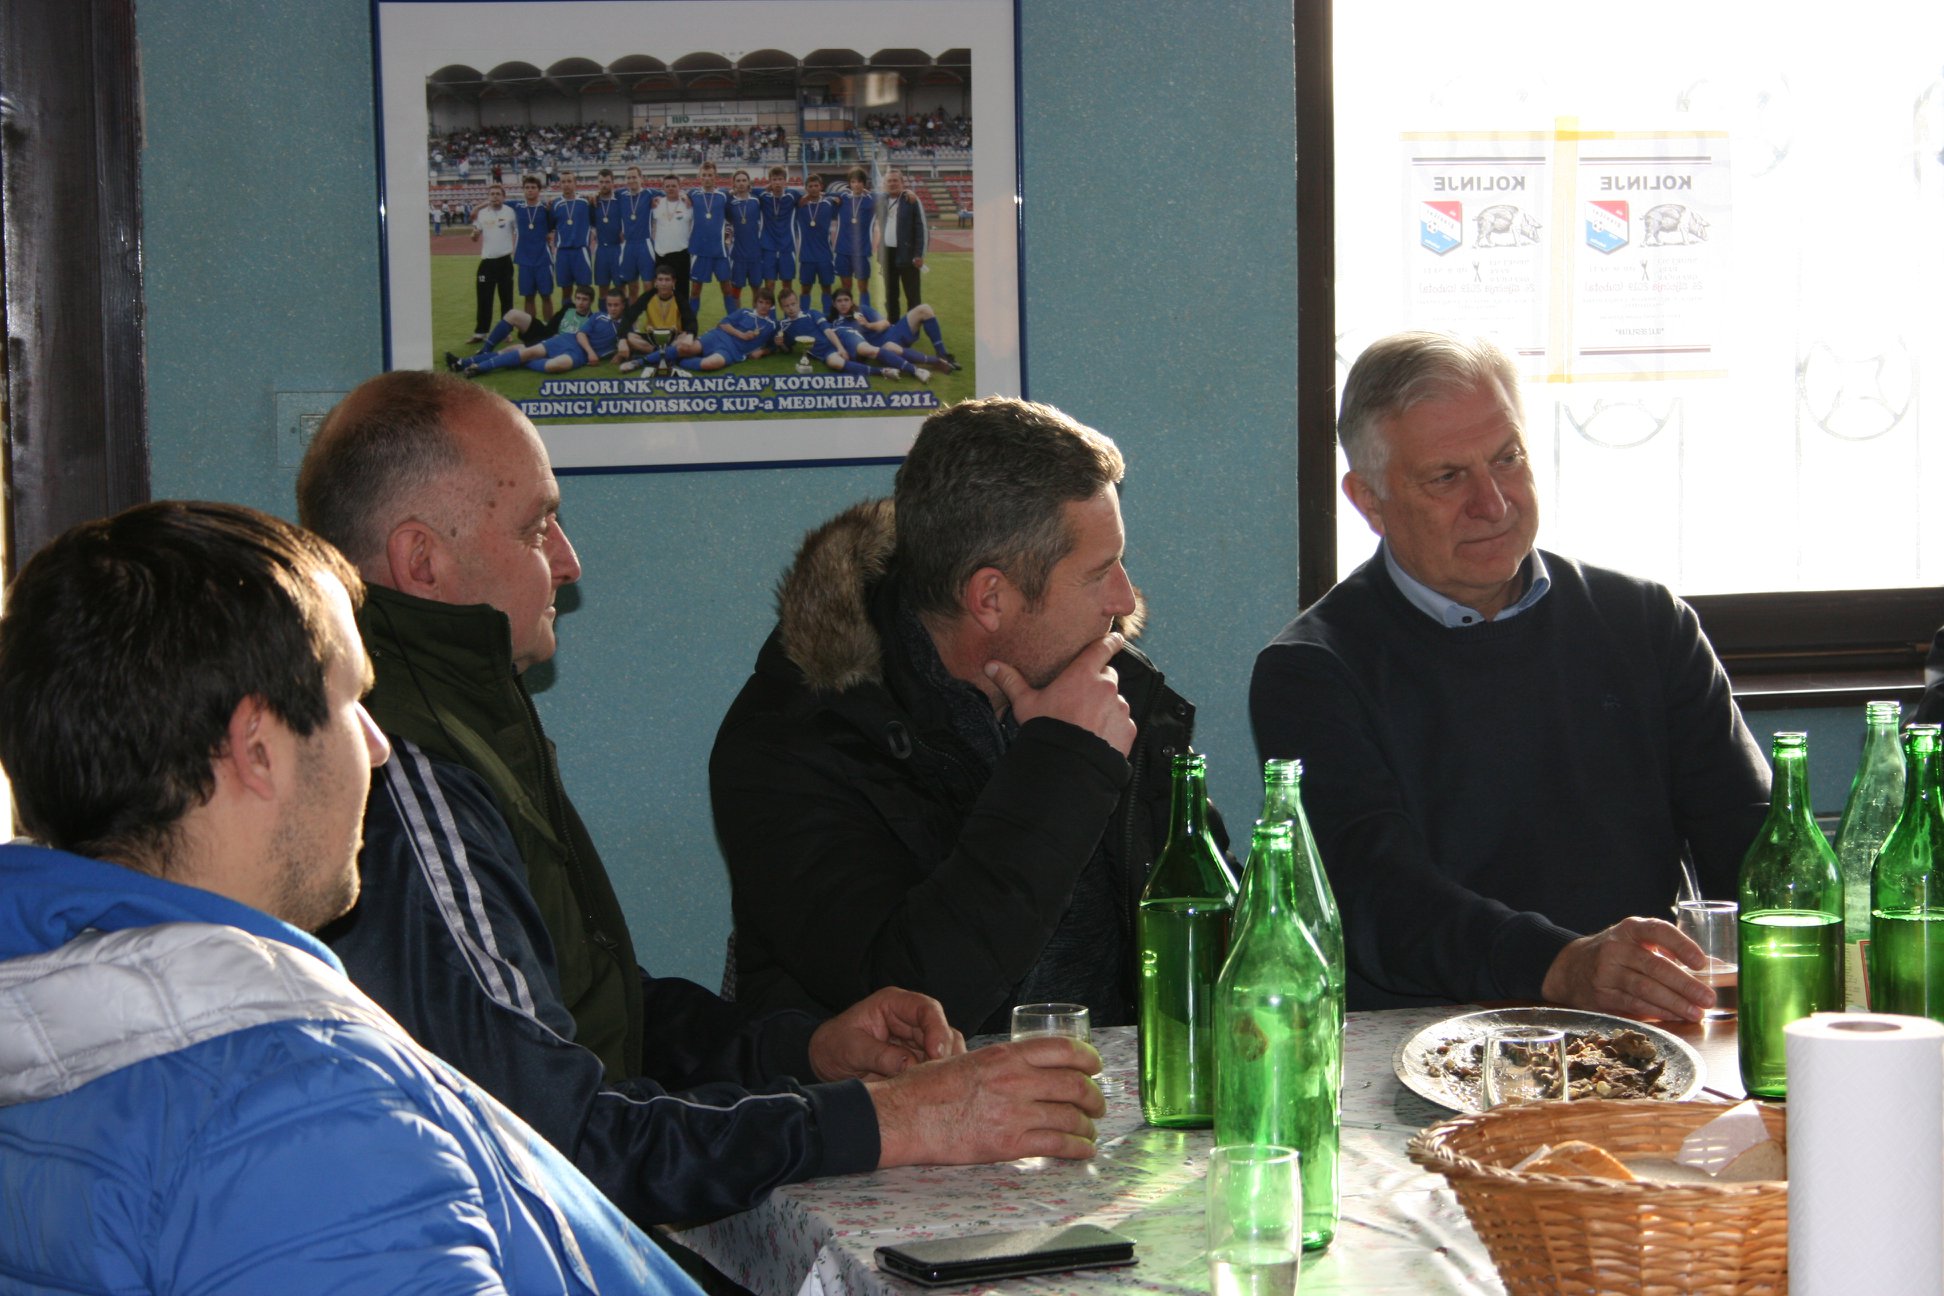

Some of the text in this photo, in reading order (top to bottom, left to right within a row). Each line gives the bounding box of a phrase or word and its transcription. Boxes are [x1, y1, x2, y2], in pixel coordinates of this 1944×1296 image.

[541, 375, 868, 395] JUNIORI NK “GRANIČAR” KOTORIBA
[521, 393, 938, 415] JEDNICI JUNIORSKOG KUP-a MEĐIMURJA 2011.
